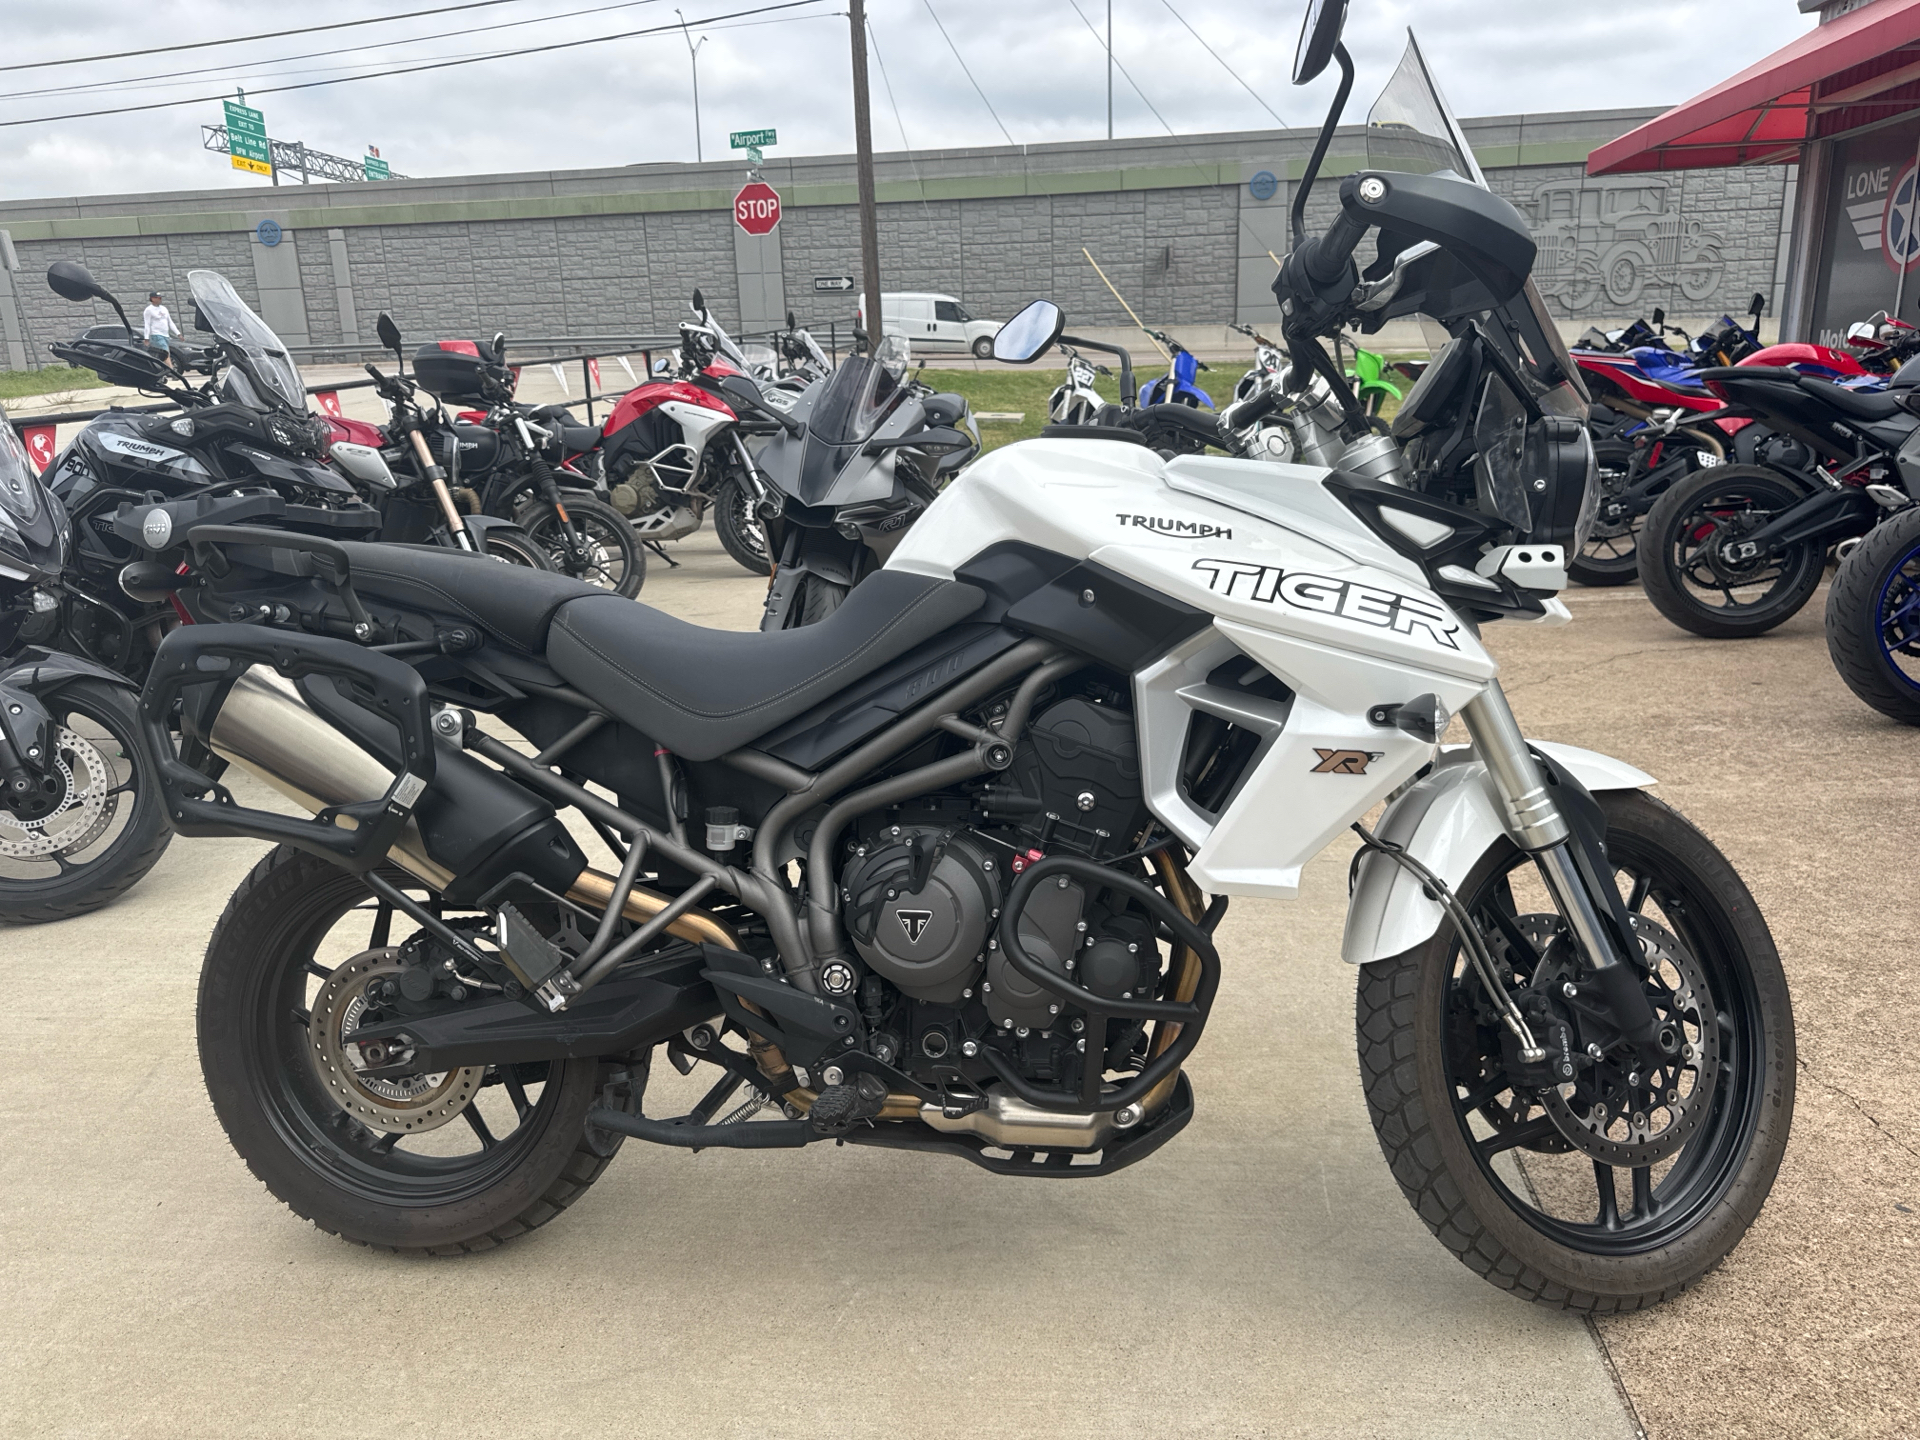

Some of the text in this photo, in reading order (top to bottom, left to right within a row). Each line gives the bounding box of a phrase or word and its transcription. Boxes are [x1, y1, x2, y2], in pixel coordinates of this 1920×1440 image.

[238, 120, 248, 129] EXIT
[230, 132, 267, 150] Belt Line Rd
[734, 131, 765, 147] Airport
[248, 150, 265, 161] Airport
[256, 163, 268, 172] ONLY
[1846, 166, 1891, 200] LONE
[738, 198, 778, 220] STOP
[669, 391, 693, 401] DUCATI
[116, 439, 166, 457] TRIUMPH
[92, 520, 115, 532] TIG
[1115, 513, 1234, 540] TRIUMPH
[1190, 557, 1462, 652] TIGER
[1560, 1026, 1570, 1062] brembo
